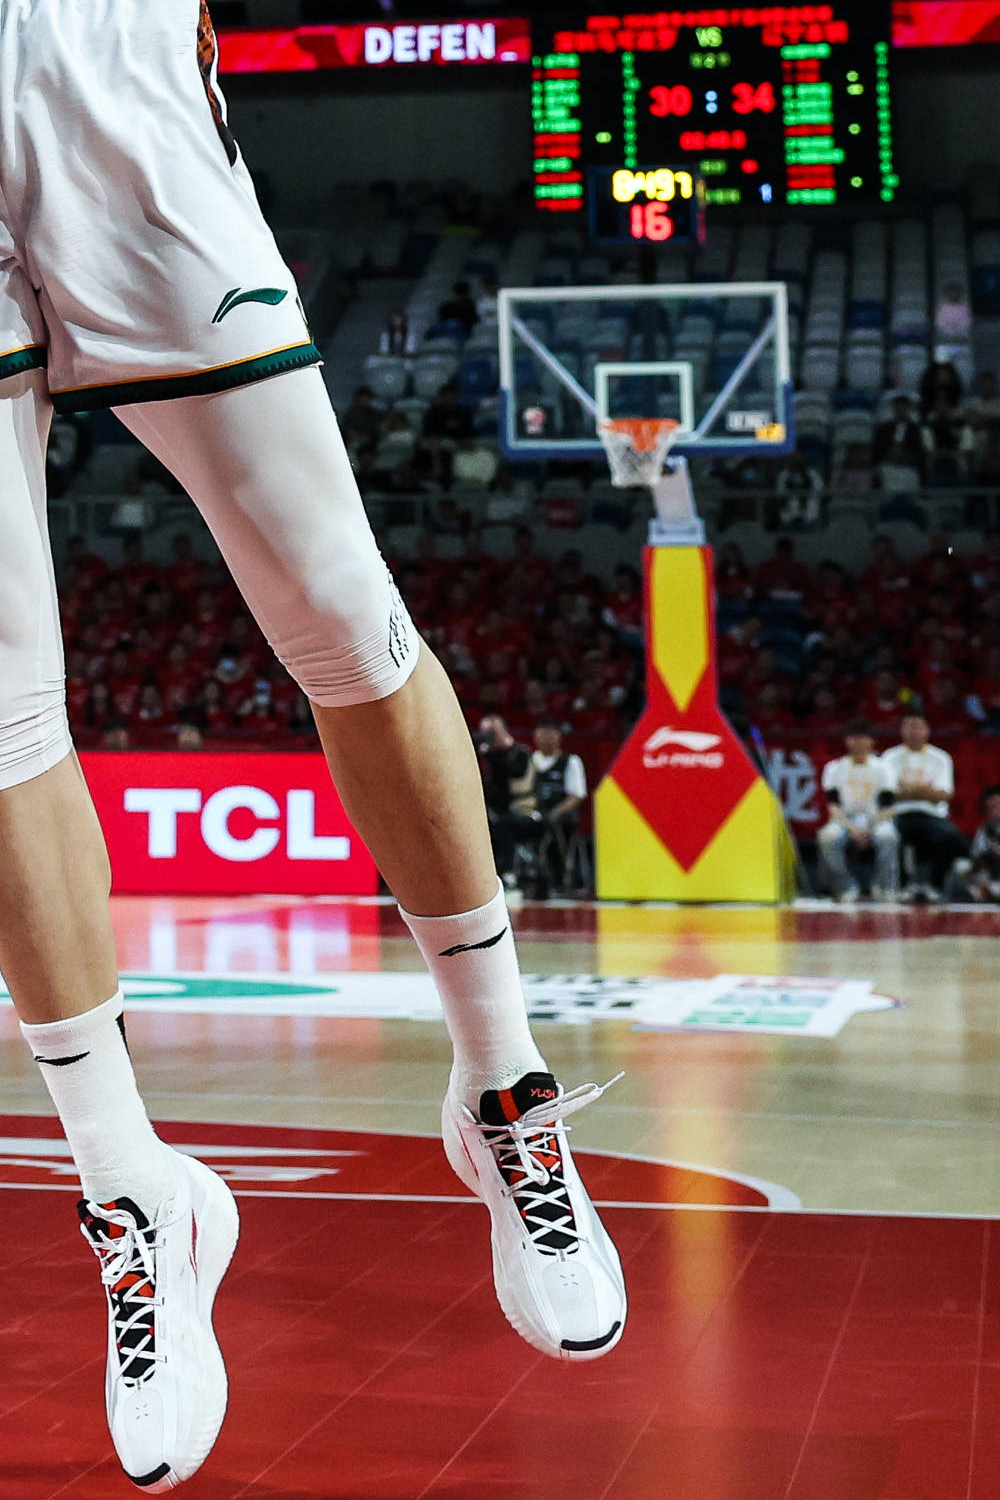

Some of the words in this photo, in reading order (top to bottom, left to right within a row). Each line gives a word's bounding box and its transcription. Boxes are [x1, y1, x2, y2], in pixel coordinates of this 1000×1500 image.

[364, 23, 518, 64] DEFEN
[630, 201, 674, 241] 16
[123, 784, 351, 862] TCL
